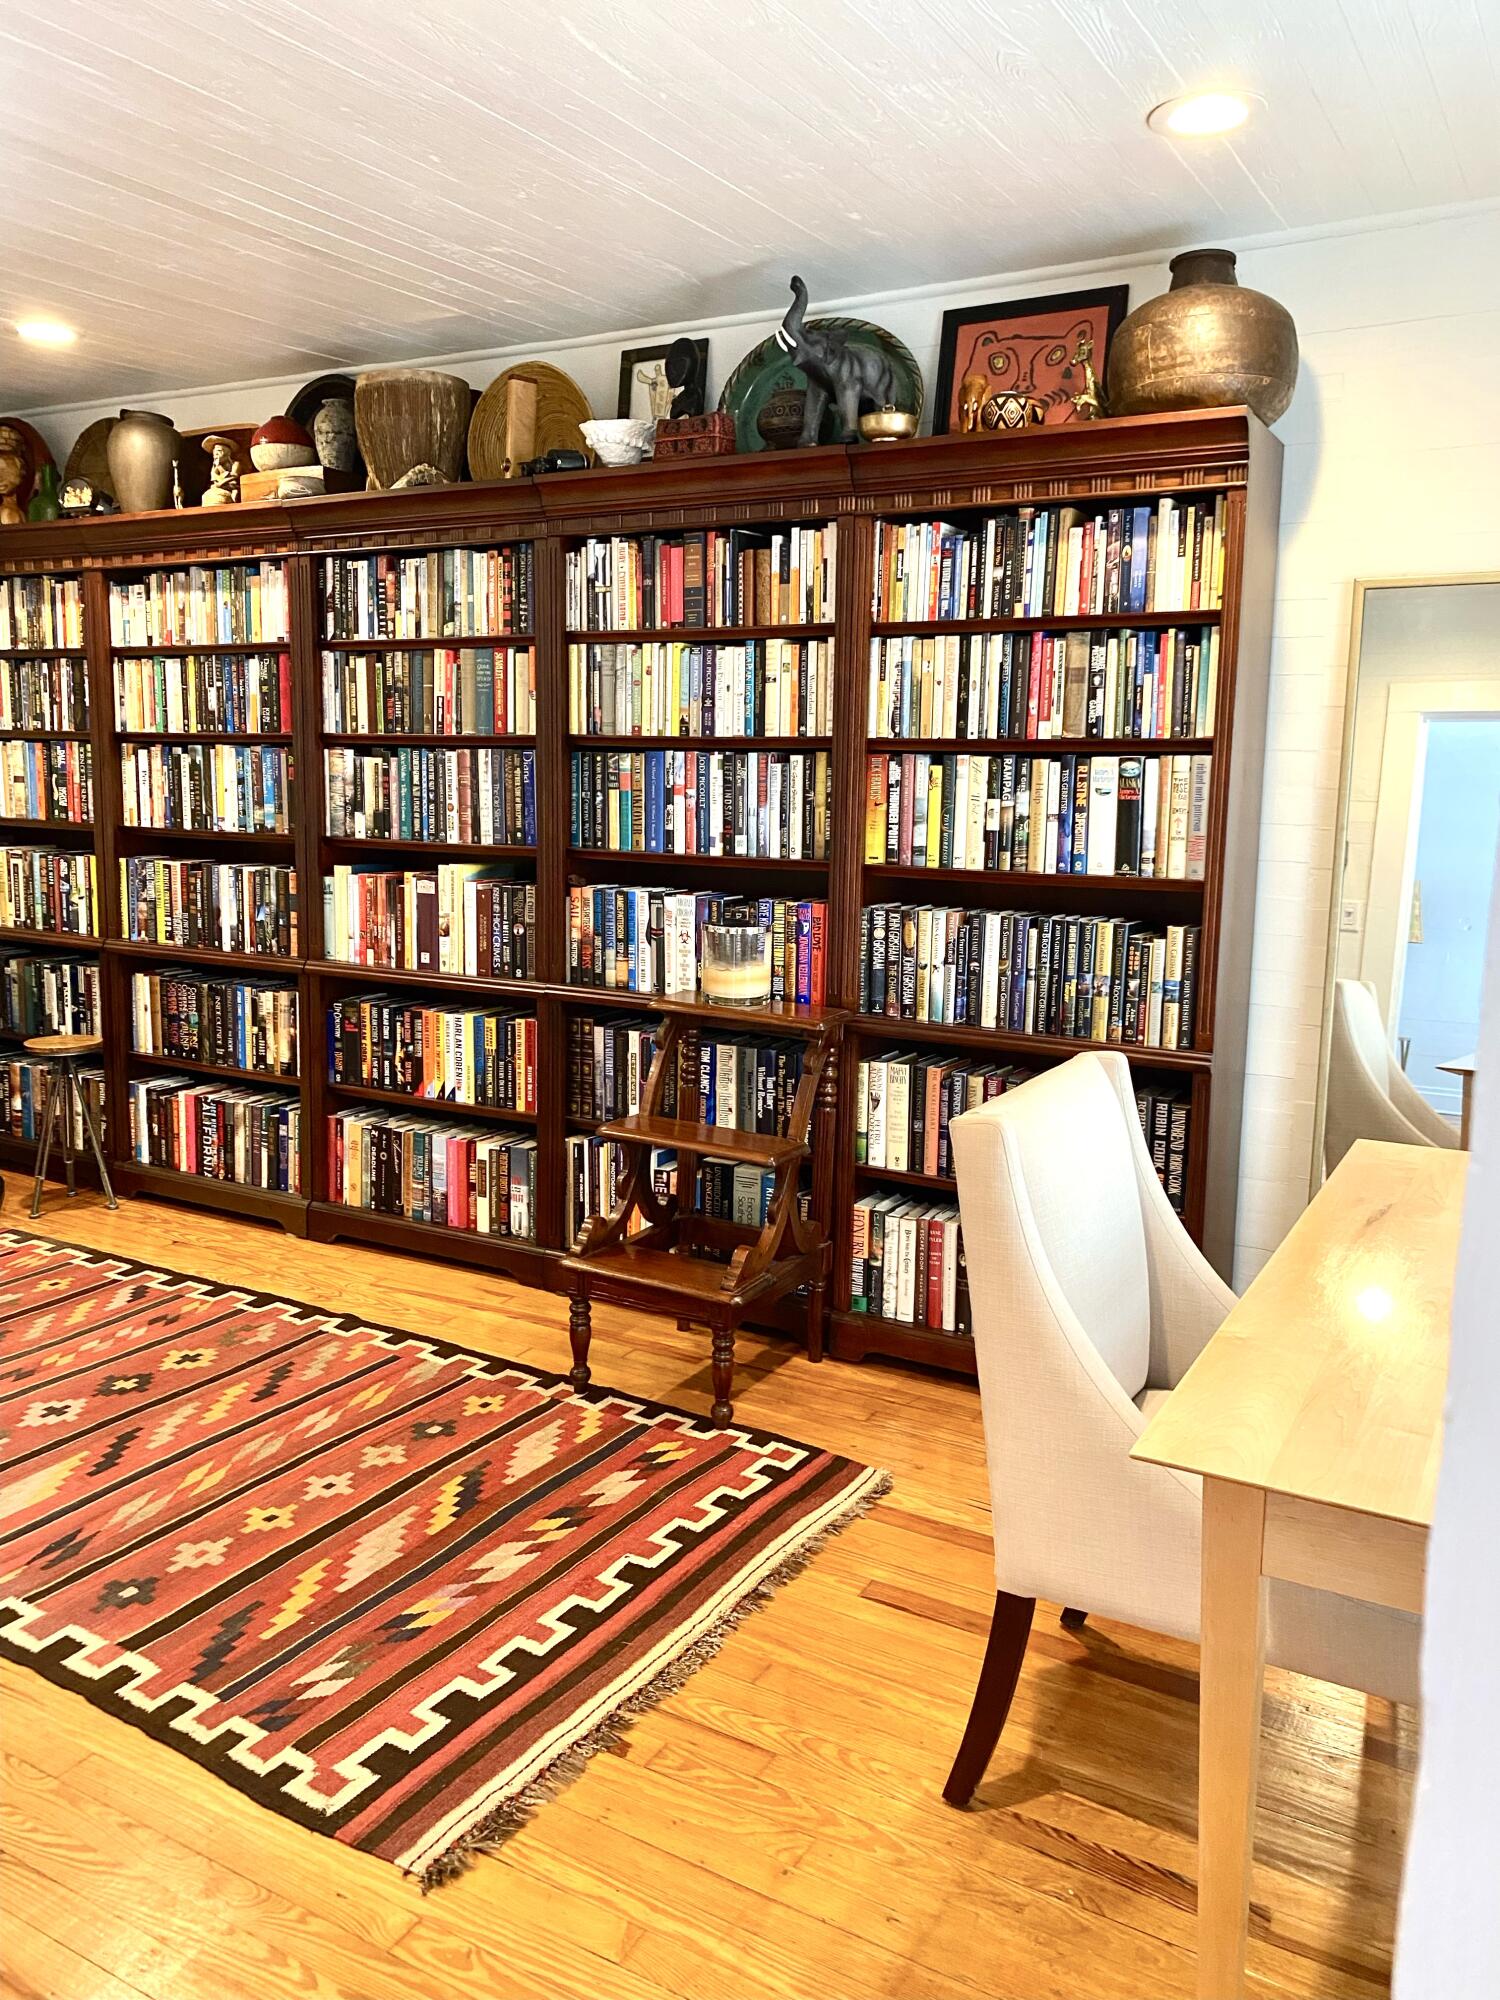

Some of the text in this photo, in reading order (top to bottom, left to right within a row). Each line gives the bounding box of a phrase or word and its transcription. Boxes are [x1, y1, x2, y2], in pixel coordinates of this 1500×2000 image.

[1088, 700, 1096, 723] GAMES
[523, 752, 533, 783] Diana
[870, 758, 882, 800] DICK FRANCIS
[633, 788, 642, 835] TAKEOVER
[1033, 783, 1044, 804] Help
[1061, 769, 1069, 814] TESS GERRITSEN
[1076, 782, 1087, 807] STINE
[1193, 763, 1207, 832] richard north patterson
[888, 787, 899, 849] THUNDER POINT
[570, 896, 580, 921] SAIL
[606, 898, 614, 950] BEACH HOUSE
[493, 936, 501, 967] CRIMES
[813, 917, 821, 952] BAD LOVE
[873, 909, 885, 969] JOHN GRISHAM
[888, 912, 900, 960] JOHN GRISHAM
[1041, 933, 1050, 963] BROKER
[1067, 925, 1077, 976] JOHN GRISHAM
[1082, 925, 1093, 971] JOHN GRISHAM
[1115, 928, 1124, 976] JOHN GRISHAM
[799, 935, 808, 995] JONATHAN KELLERMAN
[903, 956, 914, 1004] JOHN GRISHAM
[970, 976, 978, 989] JOHN
[1185, 950, 1193, 975] APPEAL
[888, 977, 896, 1003] CHAMBER
[1000, 976, 1008, 992] JOHN
[1038, 977, 1047, 1031] JOHN GRISHAM
[1112, 985, 1120, 1014] ROOSTER
[1182, 1000, 1190, 1030] GRISHAM
[700, 1047, 710, 1094] TOM CLANCY
[757, 1067, 765, 1090] Without
[953, 1077, 961, 1093] JOHN
[765, 1077, 776, 1110] Tom Clancy
[785, 1078, 794, 1117] Tom Clancy
[202, 1097, 212, 1177] CALIFORNIA
[1153, 1103, 1168, 1169] ROBIN COOK
[1170, 1109, 1186, 1150] MINDBEND
[1168, 1154, 1183, 1195] ROBIN COOK
